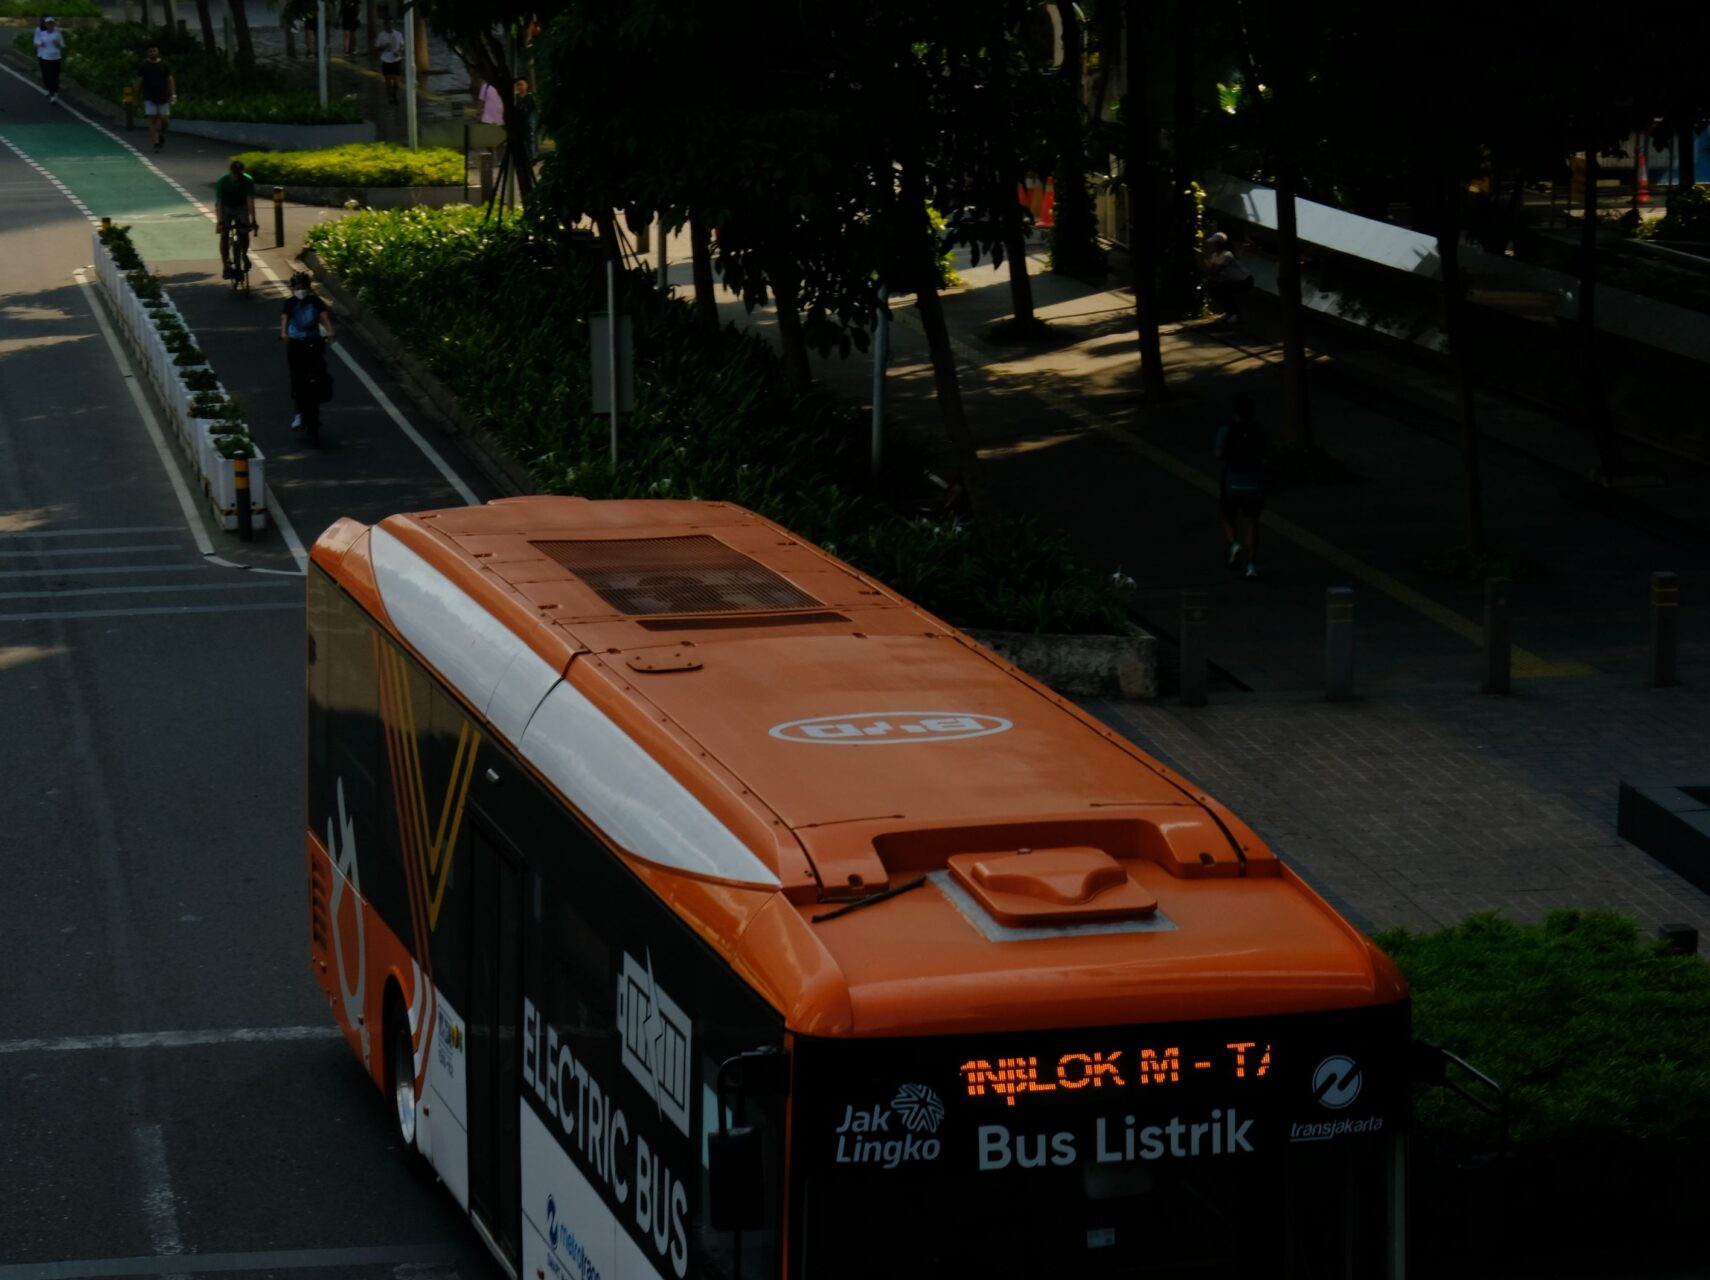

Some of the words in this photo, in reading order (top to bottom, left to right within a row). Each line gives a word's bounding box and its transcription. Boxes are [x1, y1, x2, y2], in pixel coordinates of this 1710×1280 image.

[1140, 1045, 1181, 1086] M
[522, 995, 629, 1205] ELECTRIC
[635, 1133, 689, 1280] BUS
[835, 1103, 892, 1134] Jak
[1289, 1115, 1384, 1143] transjakarta
[835, 1133, 942, 1170] Lingko
[977, 1121, 1078, 1172] Bus
[1095, 1108, 1256, 1166] Listrik
